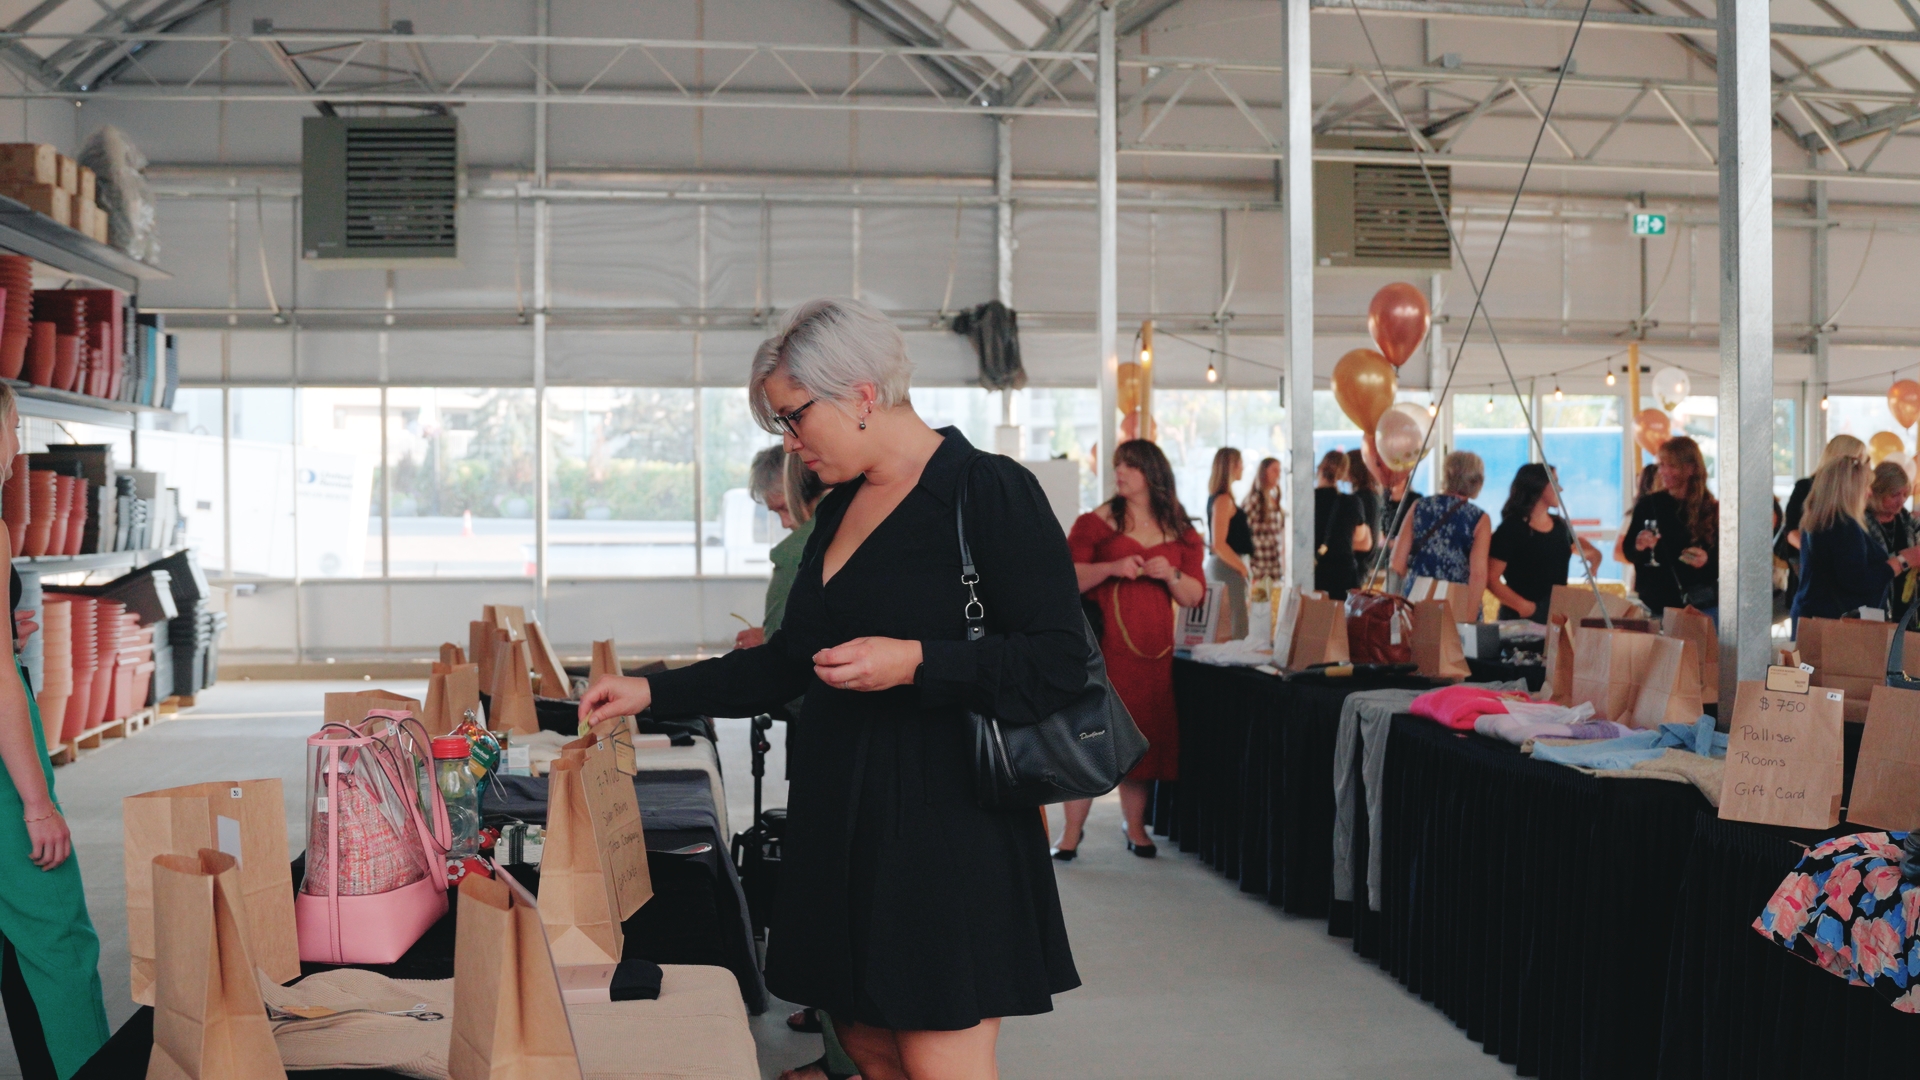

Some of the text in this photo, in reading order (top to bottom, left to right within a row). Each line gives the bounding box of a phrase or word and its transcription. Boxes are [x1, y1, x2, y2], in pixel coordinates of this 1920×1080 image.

[1759, 696, 1805, 712] $ 750
[1740, 725, 1796, 742] Palliser
[1735, 751, 1786, 767] Rooms
[1735, 782, 1805, 799] Gift Card
